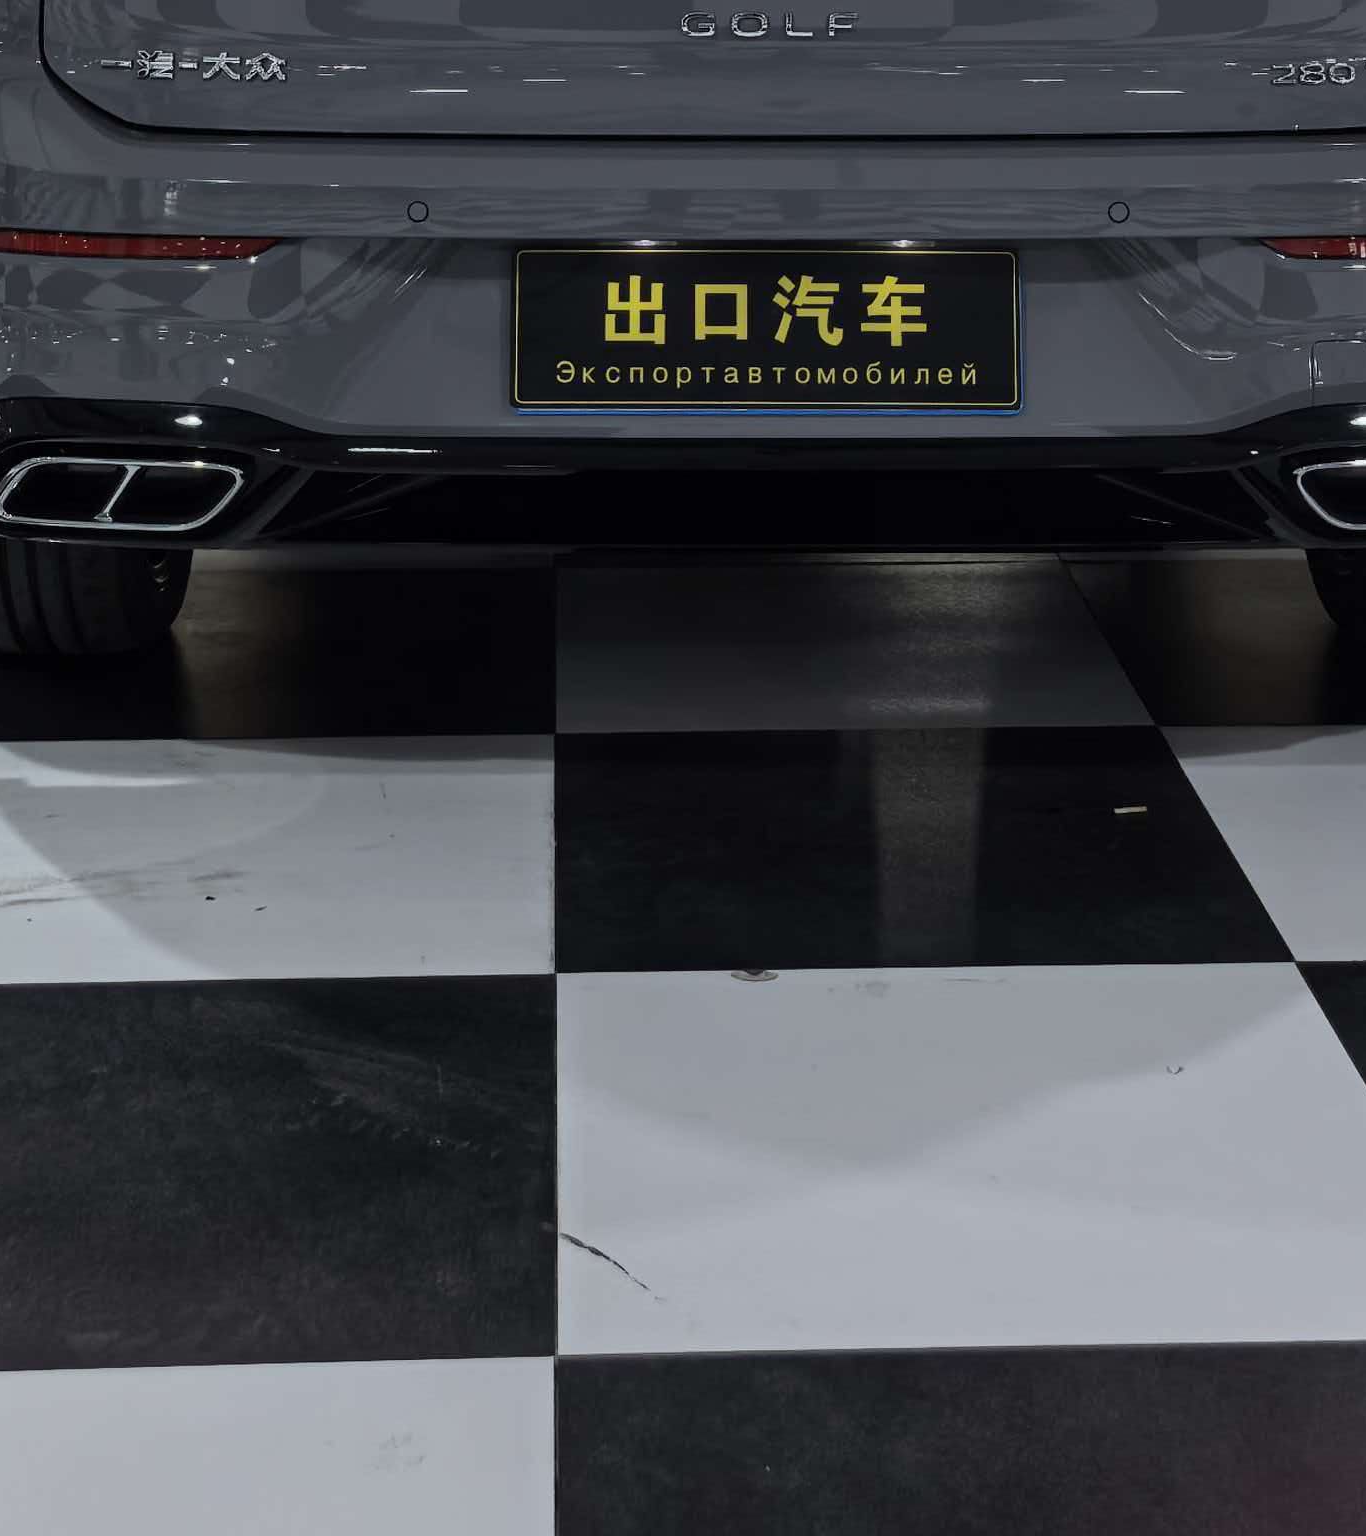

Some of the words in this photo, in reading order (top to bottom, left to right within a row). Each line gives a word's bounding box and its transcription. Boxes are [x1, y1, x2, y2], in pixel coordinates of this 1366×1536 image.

[680, 11, 859, 38] GOLF
[604, 274, 928, 347] 出口汽车
[555, 359, 979, 389] Экспортавтомобилей
